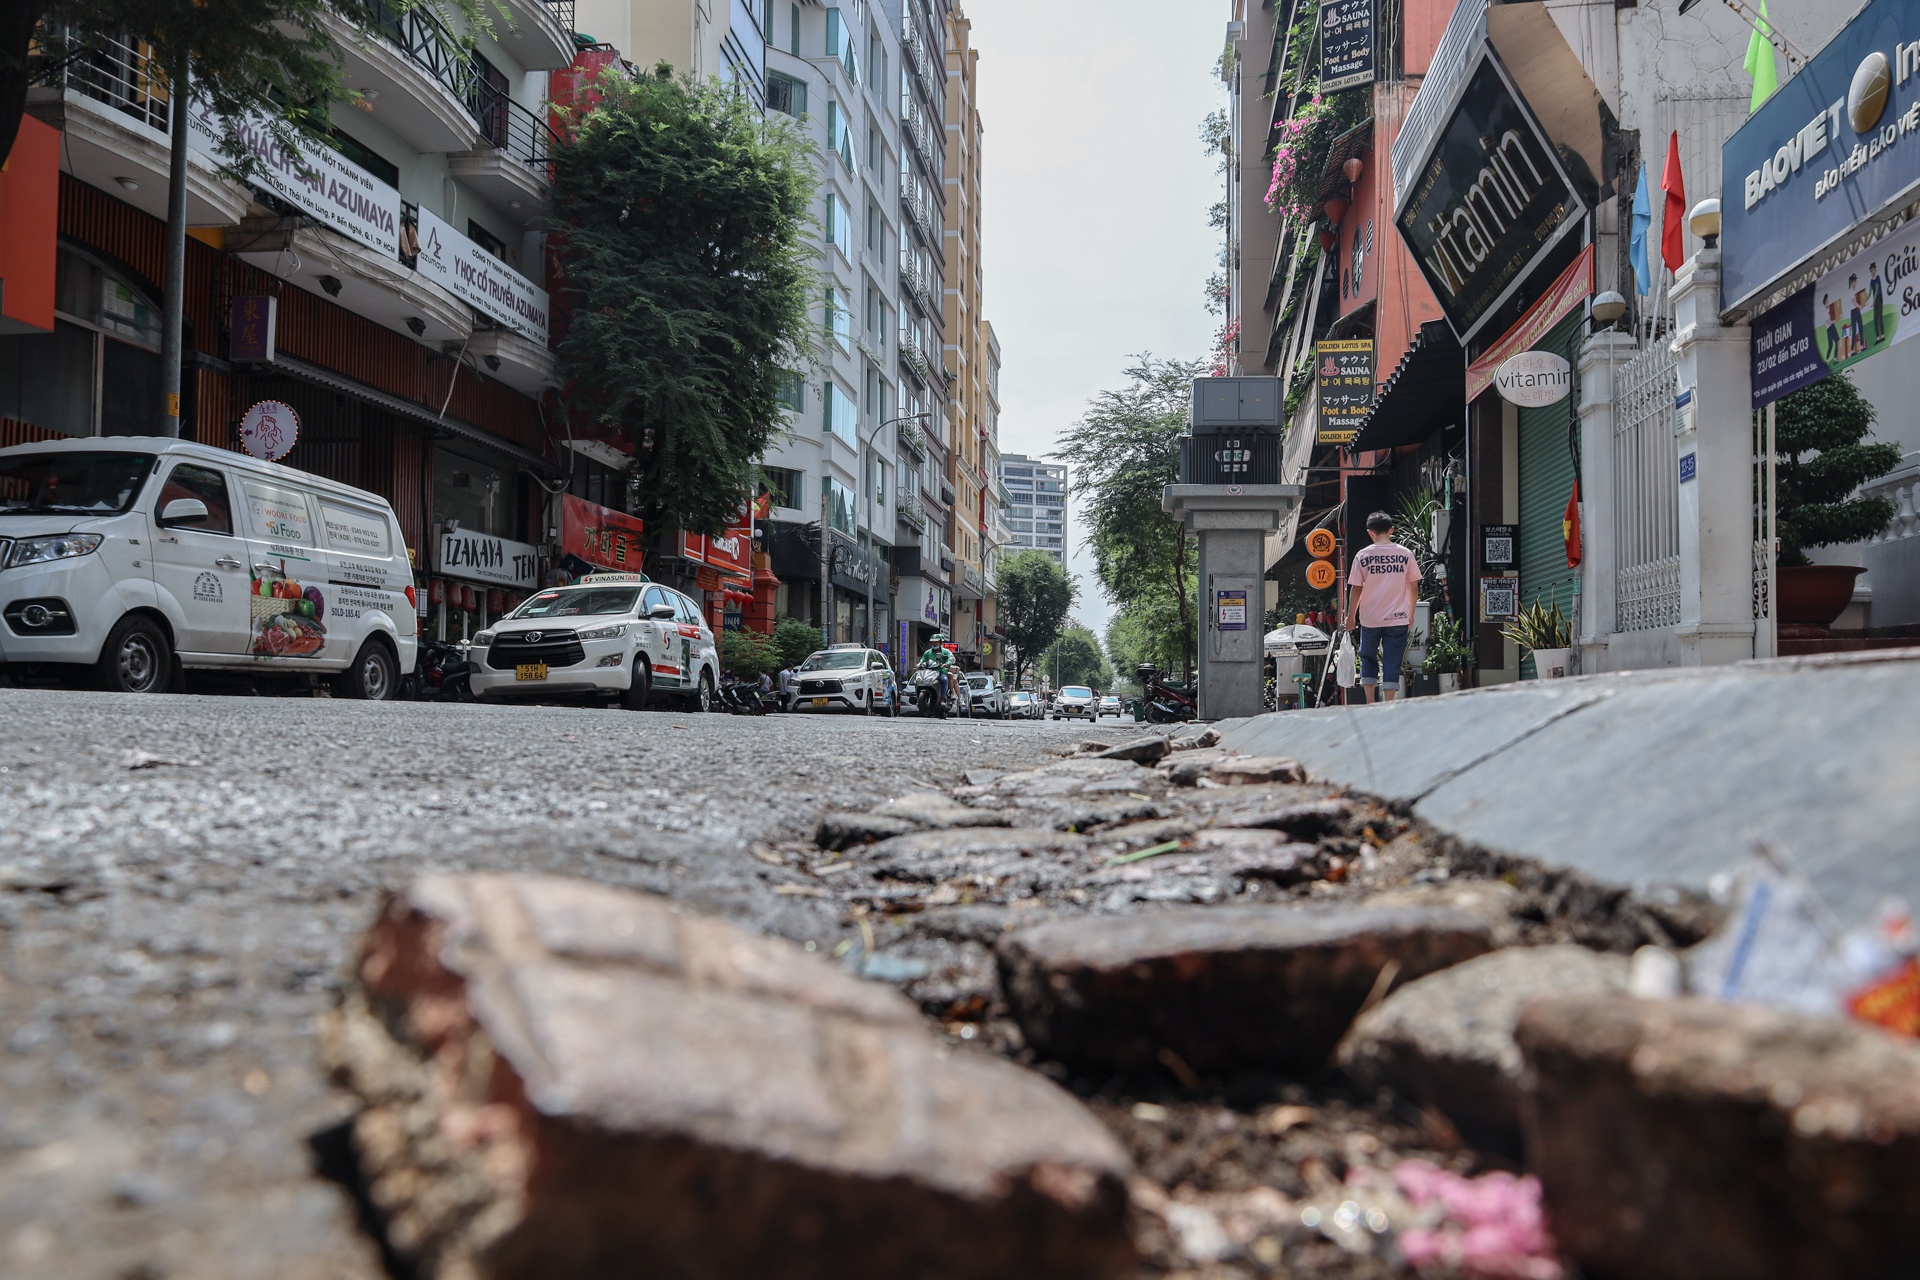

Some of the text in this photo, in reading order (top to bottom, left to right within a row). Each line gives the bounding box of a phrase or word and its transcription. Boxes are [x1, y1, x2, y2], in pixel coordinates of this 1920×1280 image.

[1342, 9, 1370, 23] SAUNA
[1326, 34, 1368, 54] マッサージ
[1324, 55, 1340, 66] Foot
[1351, 47, 1370, 59] Body
[1331, 59, 1364, 75] Massage
[1321, 72, 1373, 90] GOLDEN LOTUS SPA
[1745, 96, 1844, 210] BAOVIET
[1815, 170, 1839, 200] BẢO
[1839, 144, 1868, 182] HIỂM
[1869, 125, 1896, 159] BẢO
[237, 121, 290, 176] KHÁCH
[327, 178, 395, 237] AZUMAYA
[337, 161, 359, 183] THÀNH
[360, 176, 374, 192] VIÊN
[1425, 128, 1543, 298] vitamin
[302, 195, 315, 209] Văn
[315, 203, 330, 220] Lung,
[383, 242, 395, 254] HCM
[420, 251, 447, 274] azumaya
[472, 249, 486, 263] CÔNG
[1884, 245, 1919, 296] Giải
[454, 255, 547, 331] Y HỌC CỔ AZUMAYA
[1757, 321, 1792, 354] THỜI GIAN
[1340, 355, 1369, 365] サウナ
[1511, 357, 1559, 369] 가라오케
[1757, 337, 1809, 375] 23/02 đến 15/03
[1340, 366, 1370, 376] SAUNA
[1323, 393, 1369, 406] マッサージ
[1520, 389, 1556, 402] 노래방
[1322, 406, 1339, 415] Foot
[1350, 405, 1370, 416] Body
[289, 514, 307, 523] FOOD
[584, 527, 626, 563] 가마골
[445, 536, 535, 581] IZAKAYA TEN
[1360, 555, 1408, 568] EXPRESSION
[476, 569, 486, 577] TOKYO
[487, 571, 502, 579] DRINKING
[1317, 570, 1325, 580] 17
